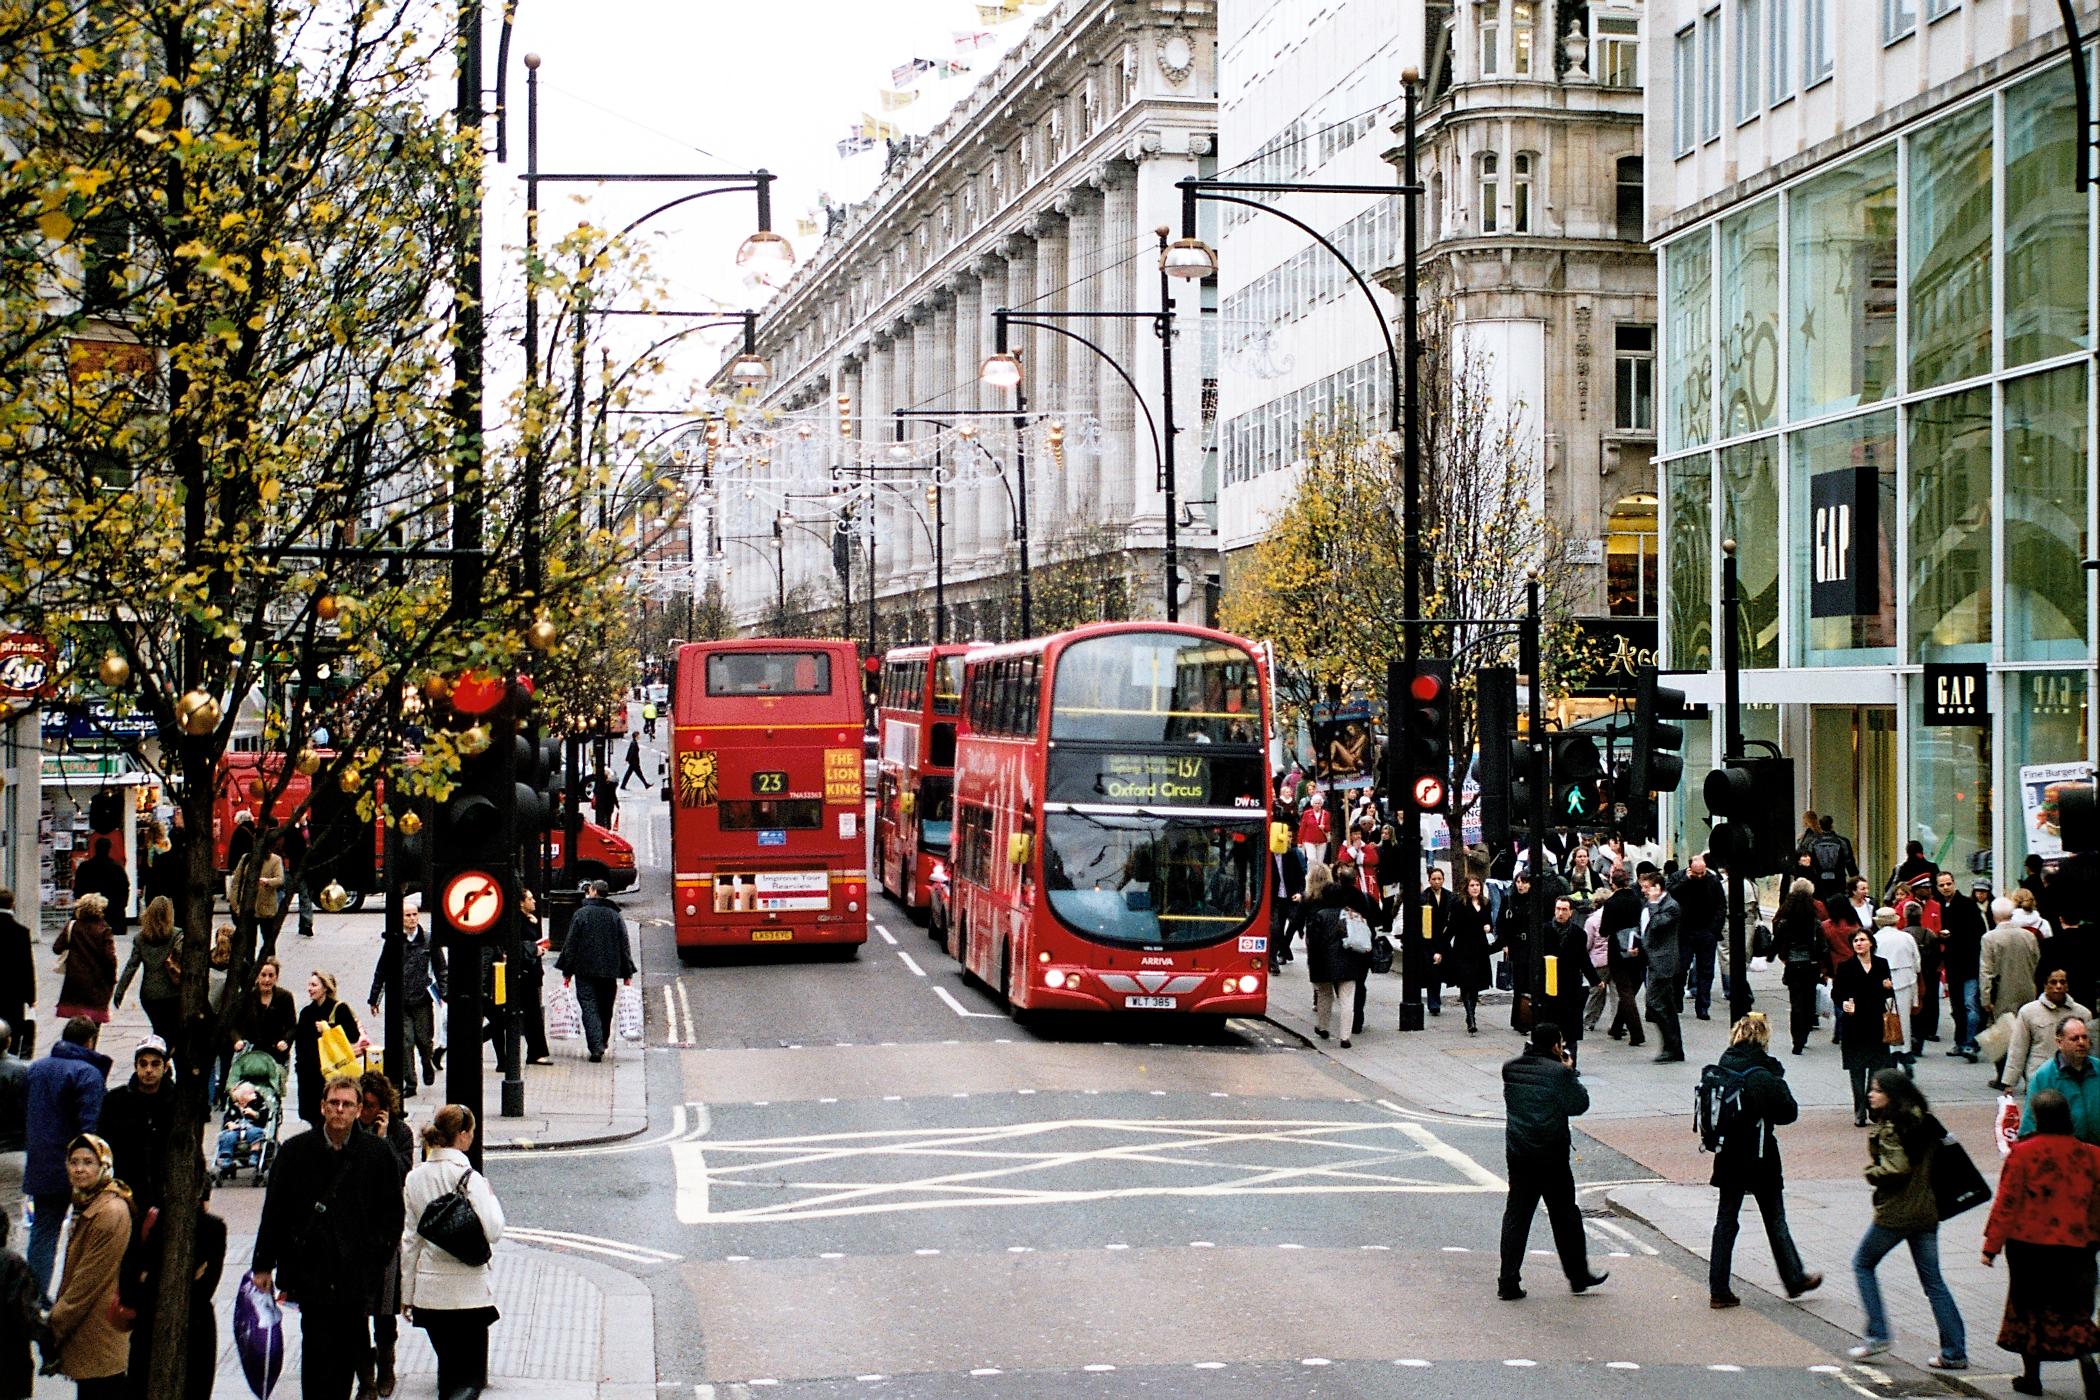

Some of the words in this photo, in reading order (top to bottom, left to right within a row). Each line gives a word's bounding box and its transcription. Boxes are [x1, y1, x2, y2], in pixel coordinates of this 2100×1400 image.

[1816, 505, 1848, 583] GAP
[1937, 675, 1976, 705] GAP
[831, 753, 854, 765] THE
[826, 767, 860, 780] LION
[2023, 770, 2043, 778] Fine
[2045, 768, 2076, 778] Burger
[759, 774, 781, 792] 23
[826, 783, 860, 795] KING
[1108, 782, 1157, 797] Oxford
[1160, 782, 1203, 797] Circus
[1234, 797, 1249, 807] DW
[1250, 799, 1260, 807] 85
[763, 874, 798, 883] Improve
[1141, 957, 1174, 966] ARRIVA
[1132, 997, 1149, 1007] WLT
[1152, 997, 1170, 1007] 385
